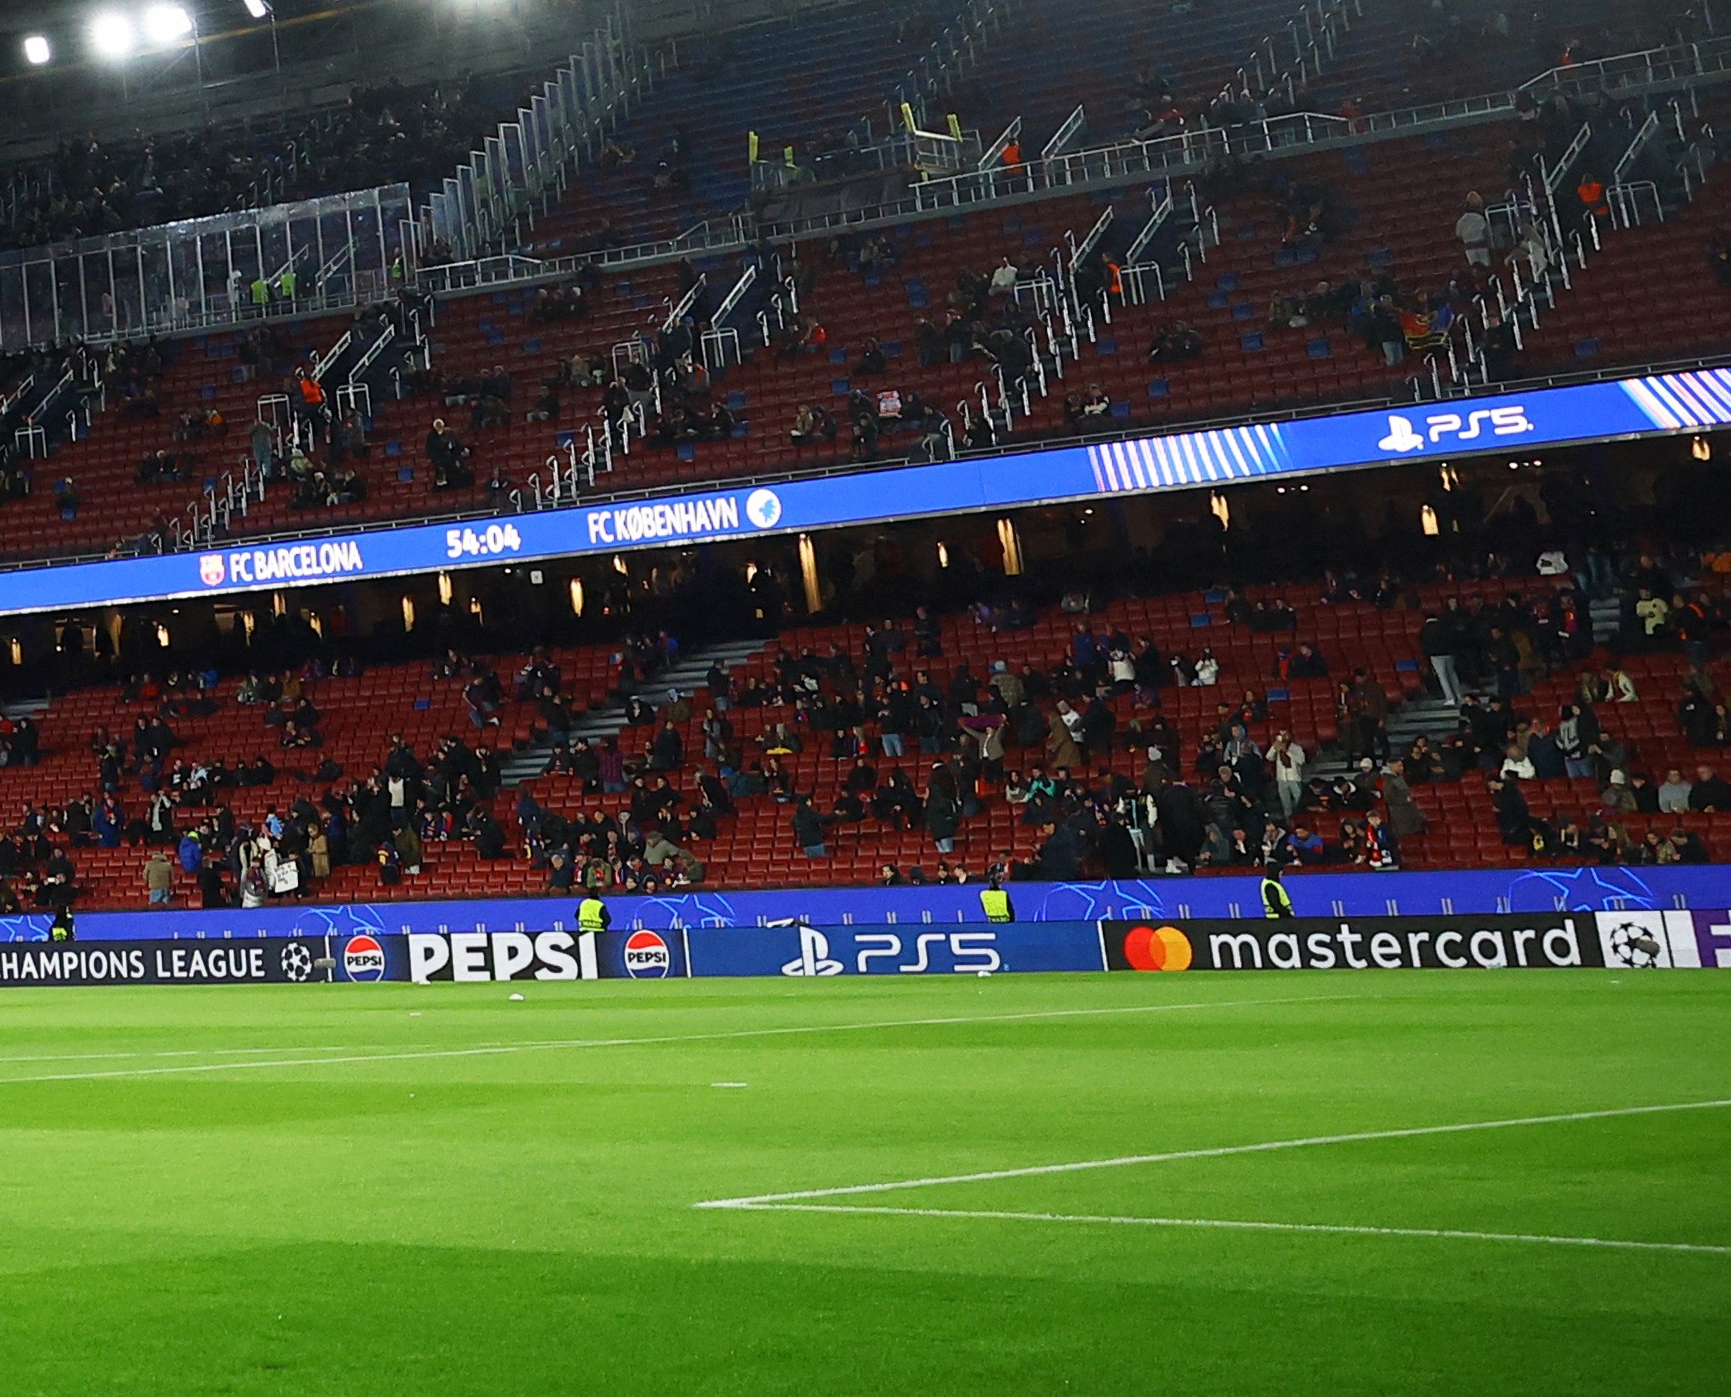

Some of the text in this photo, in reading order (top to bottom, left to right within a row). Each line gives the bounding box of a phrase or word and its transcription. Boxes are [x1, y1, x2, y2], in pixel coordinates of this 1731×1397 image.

[588, 496, 739, 544] FC KØBENHAVN
[446, 523, 521, 559] 54:04
[230, 540, 363, 583] FC BARCELONA
[156, 947, 265, 979] LEAGUE
[346, 955, 382, 967] PEPSI
[409, 931, 599, 982] PEPSI
[627, 950, 666, 964] PEPSI
[854, 932, 1001, 972] PS5
[1209, 918, 1582, 969] mastercard
